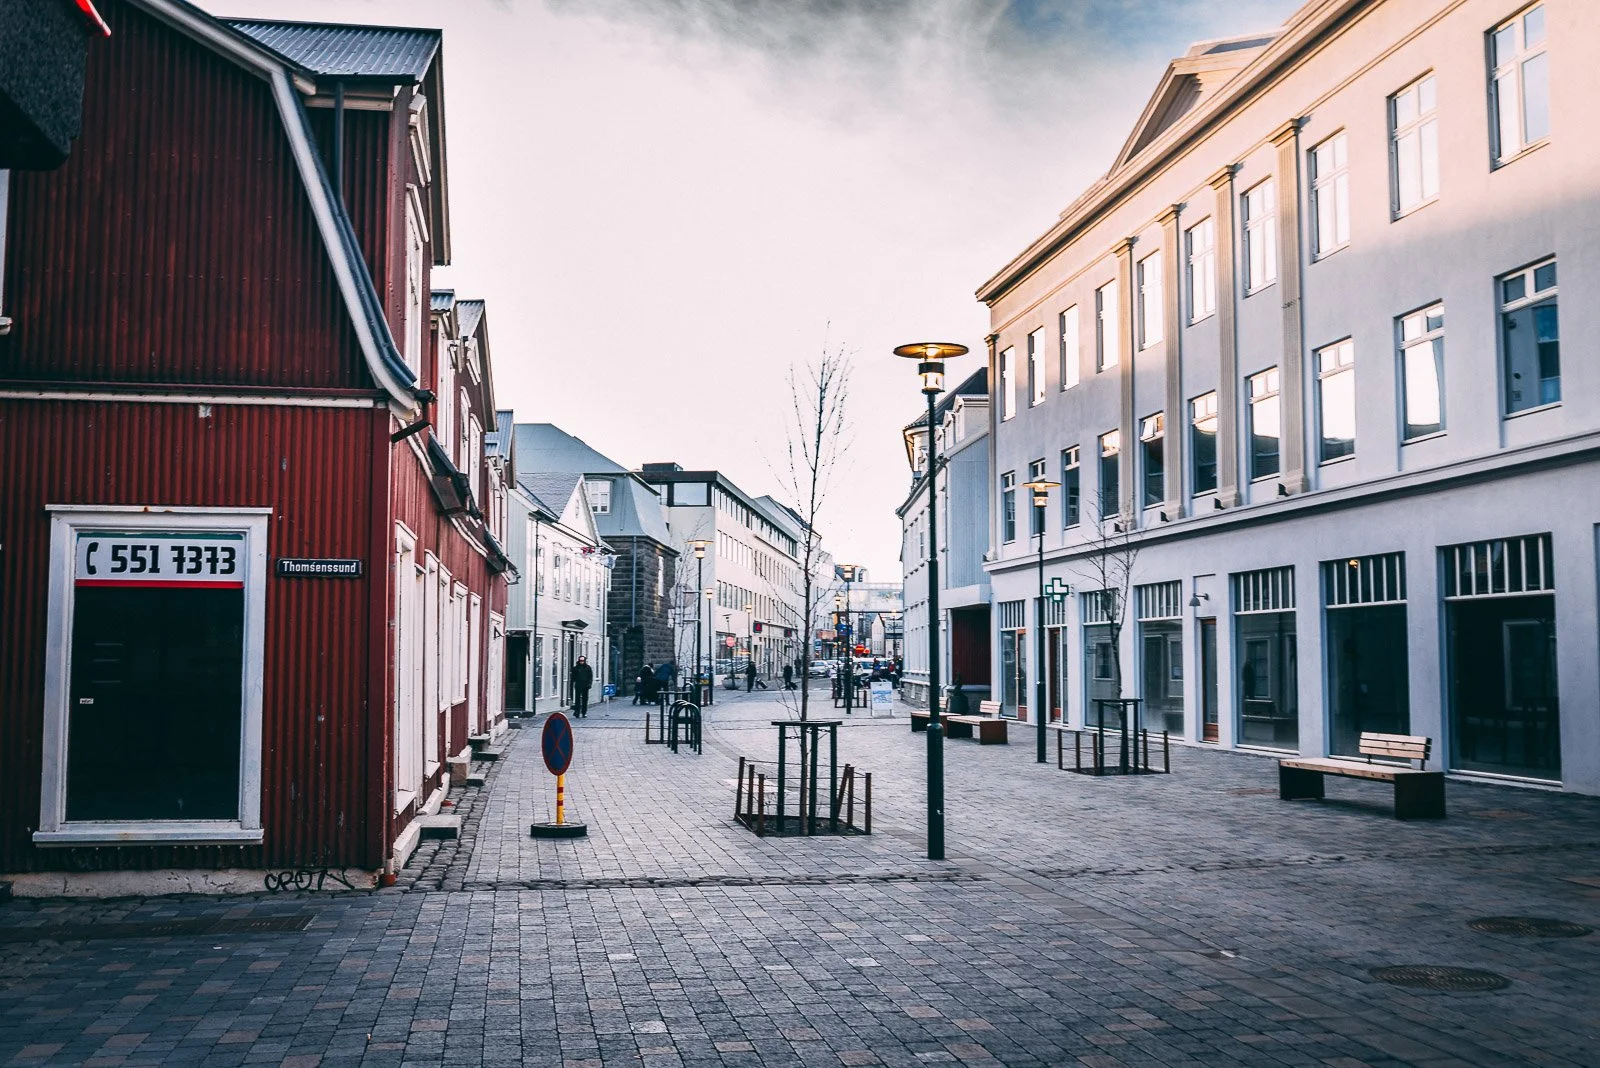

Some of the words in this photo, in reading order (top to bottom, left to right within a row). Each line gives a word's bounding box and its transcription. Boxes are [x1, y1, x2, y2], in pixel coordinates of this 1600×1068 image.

[111, 545, 160, 574] 551
[170, 545, 236, 575] 7373
[282, 561, 357, 573] Thomsenssund
